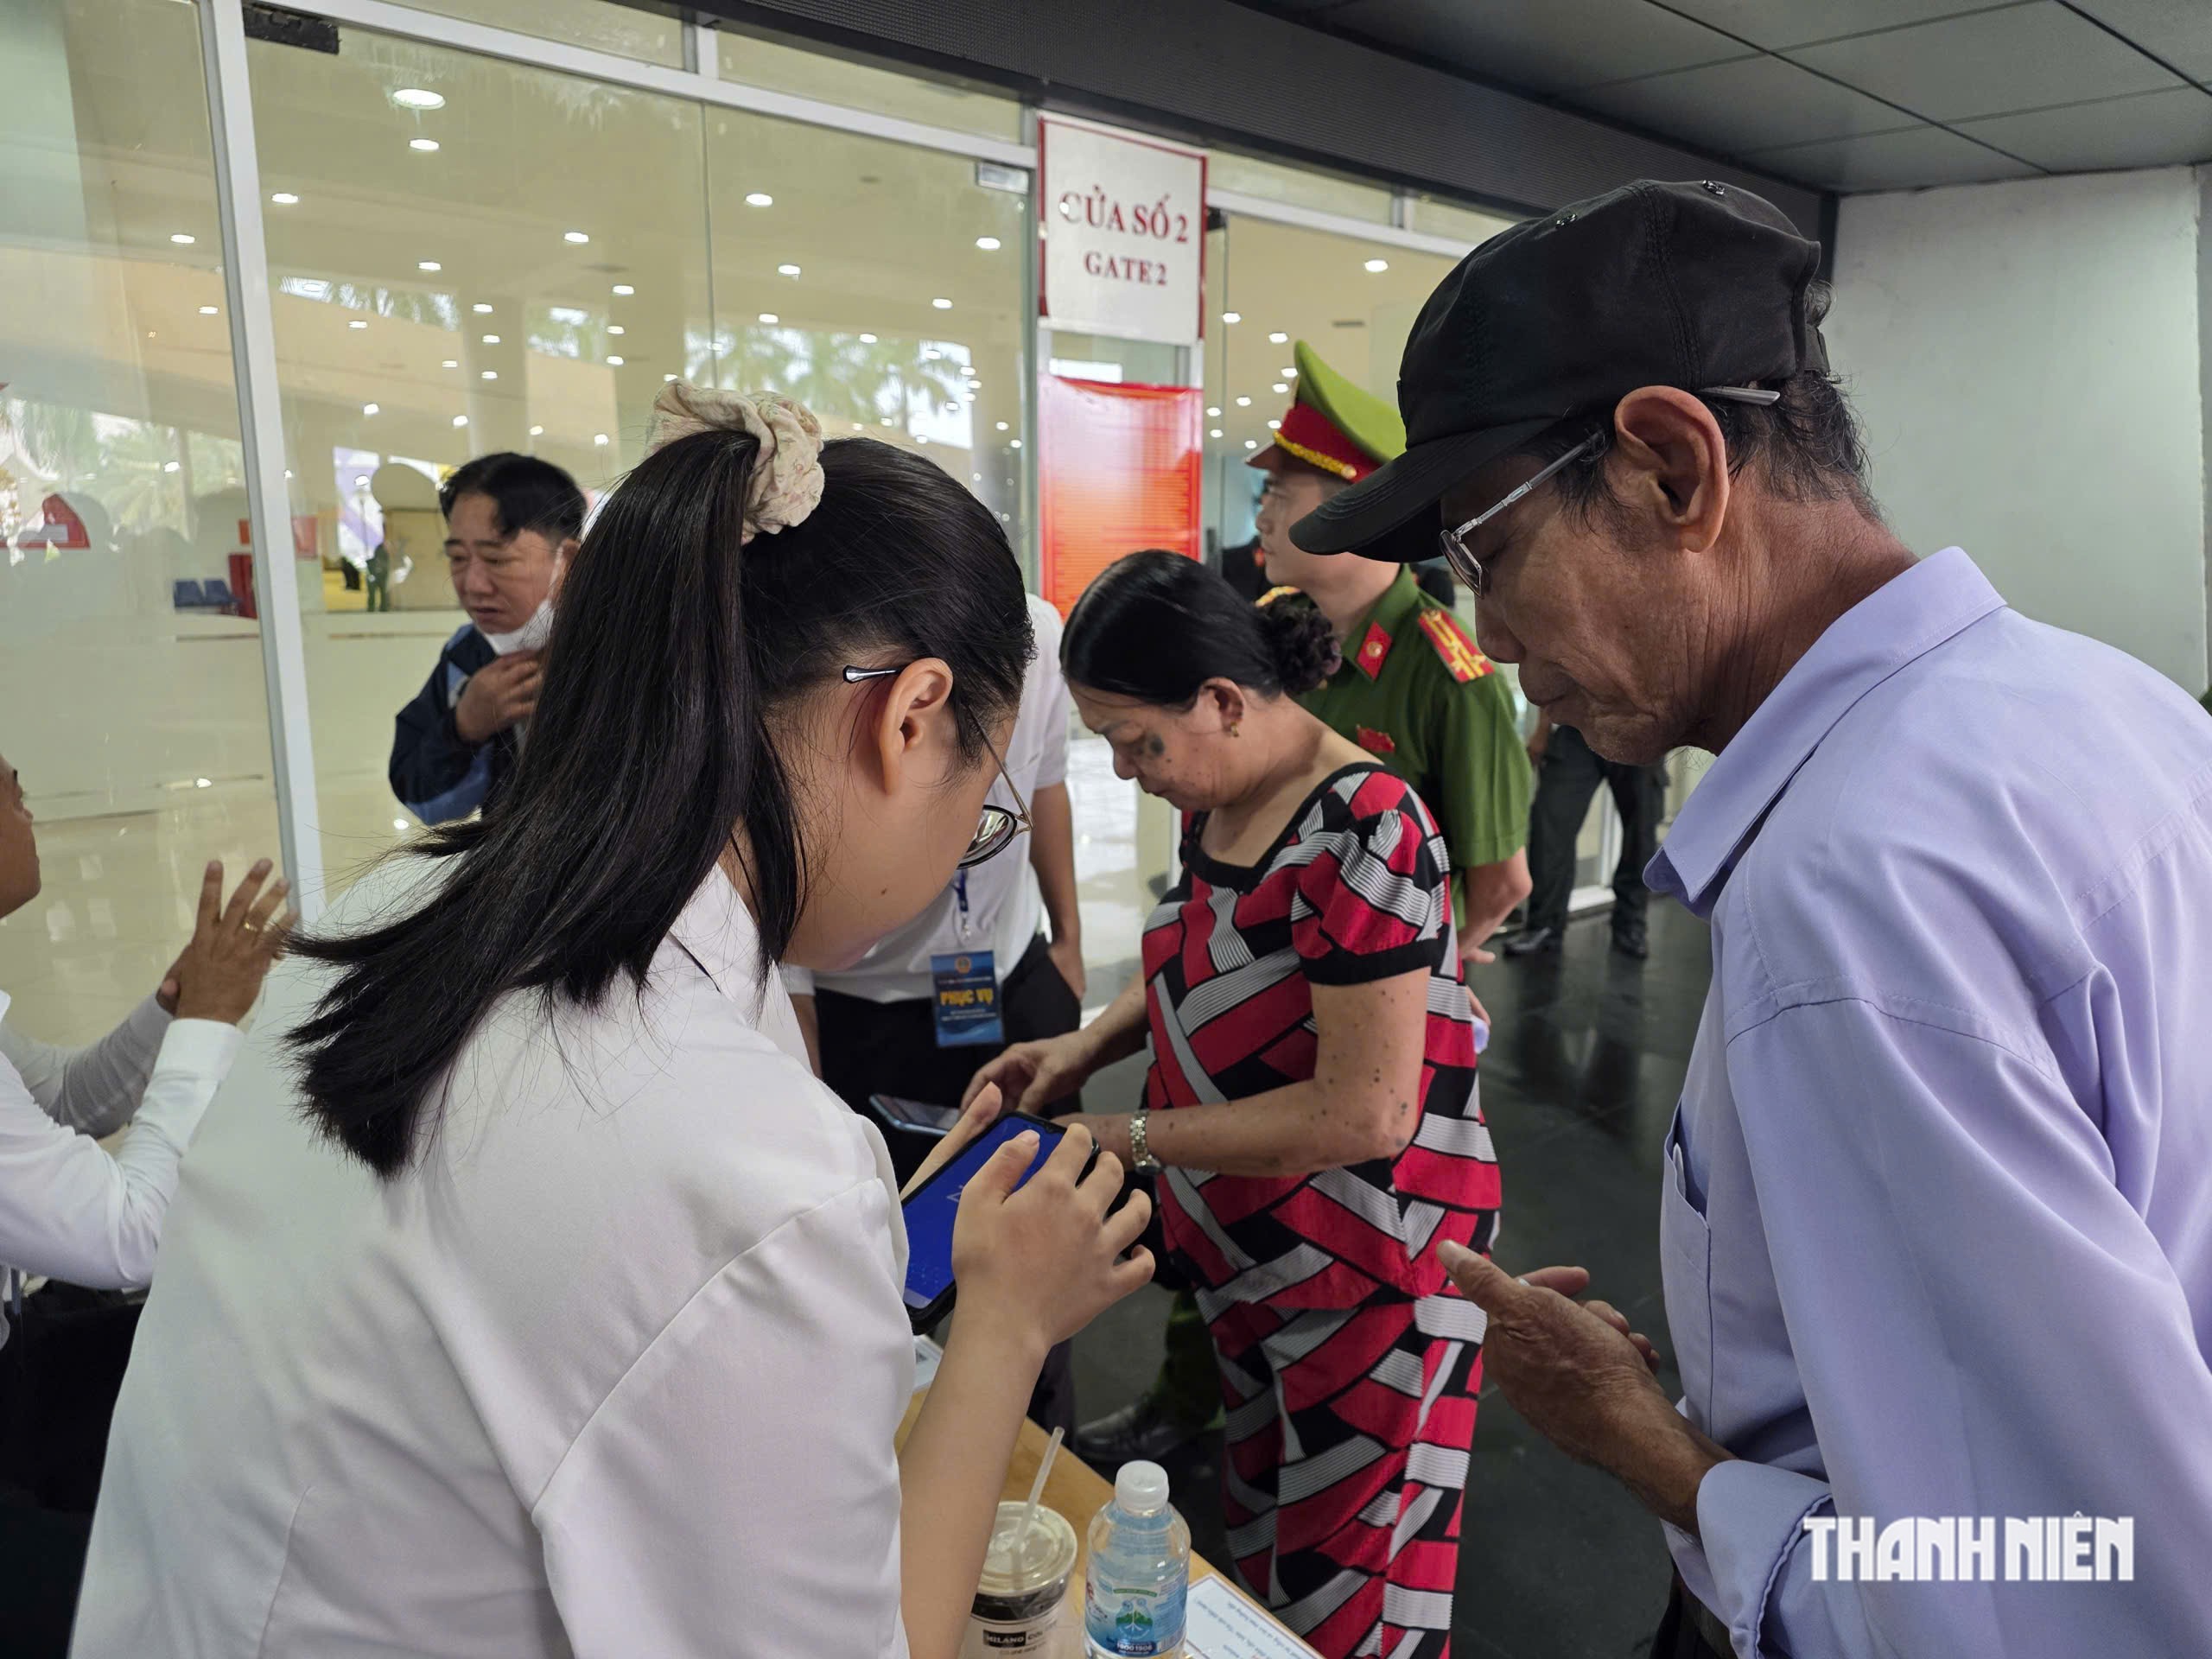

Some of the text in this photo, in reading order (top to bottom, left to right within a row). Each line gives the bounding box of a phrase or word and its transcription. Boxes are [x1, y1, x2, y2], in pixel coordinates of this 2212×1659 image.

[1059, 184, 1126, 232] CỬA
[1175, 215, 1189, 243] 2
[1084, 251, 1152, 284] GATE
